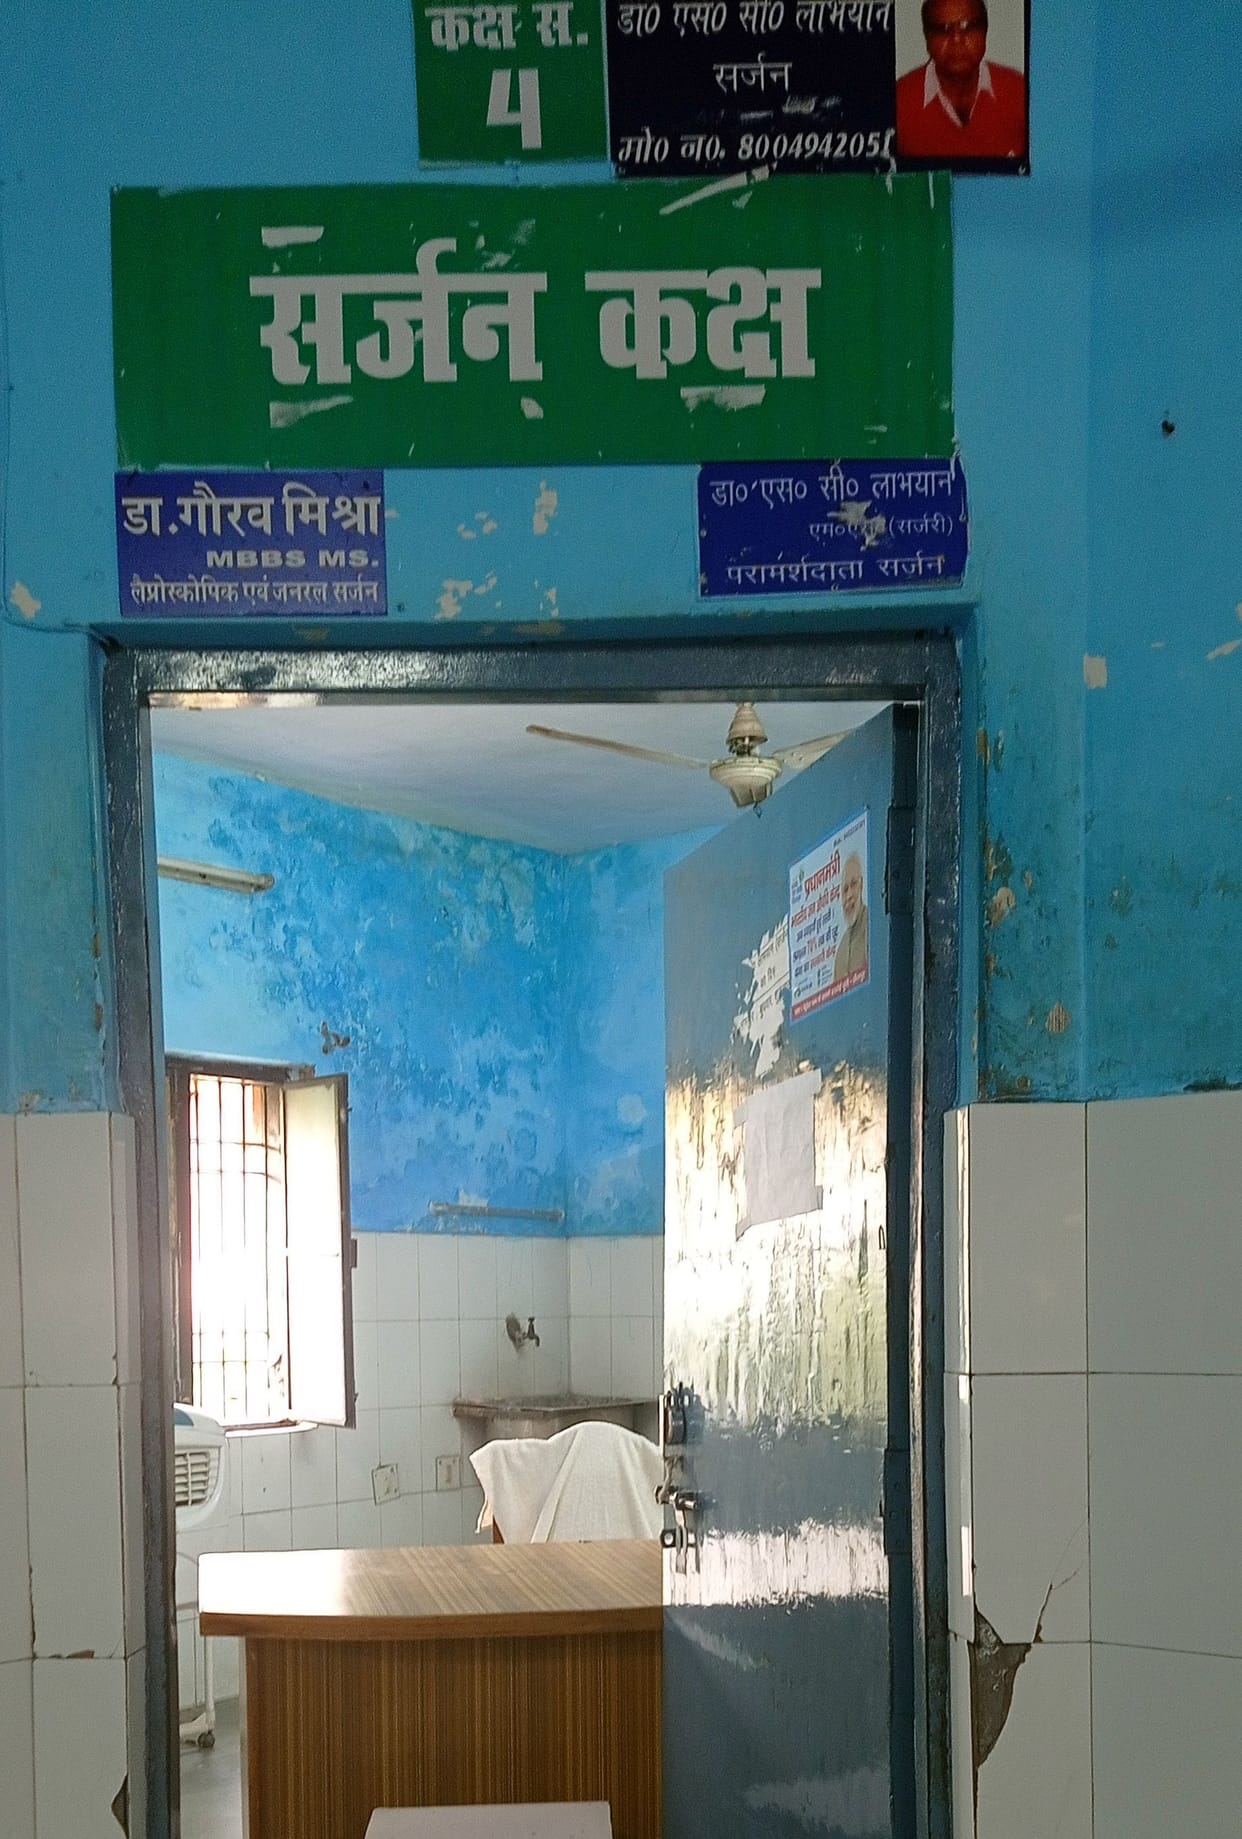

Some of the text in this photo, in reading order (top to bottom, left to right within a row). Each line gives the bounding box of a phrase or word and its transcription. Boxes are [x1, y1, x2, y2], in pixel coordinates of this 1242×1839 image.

[424, 3, 518, 51] कक्ष
[713, 51, 792, 92] सर्जन
[486, 68, 542, 149] 4
[249, 237, 821, 386] सर्जन कक्ष
[870, 469, 953, 500] लाभयान
[281, 480, 382, 537] मिश्रा
[206, 550, 380, 568] MBBS MS.
[875, 550, 945, 578] सर्जन
[332, 574, 378, 603] सर्जन
